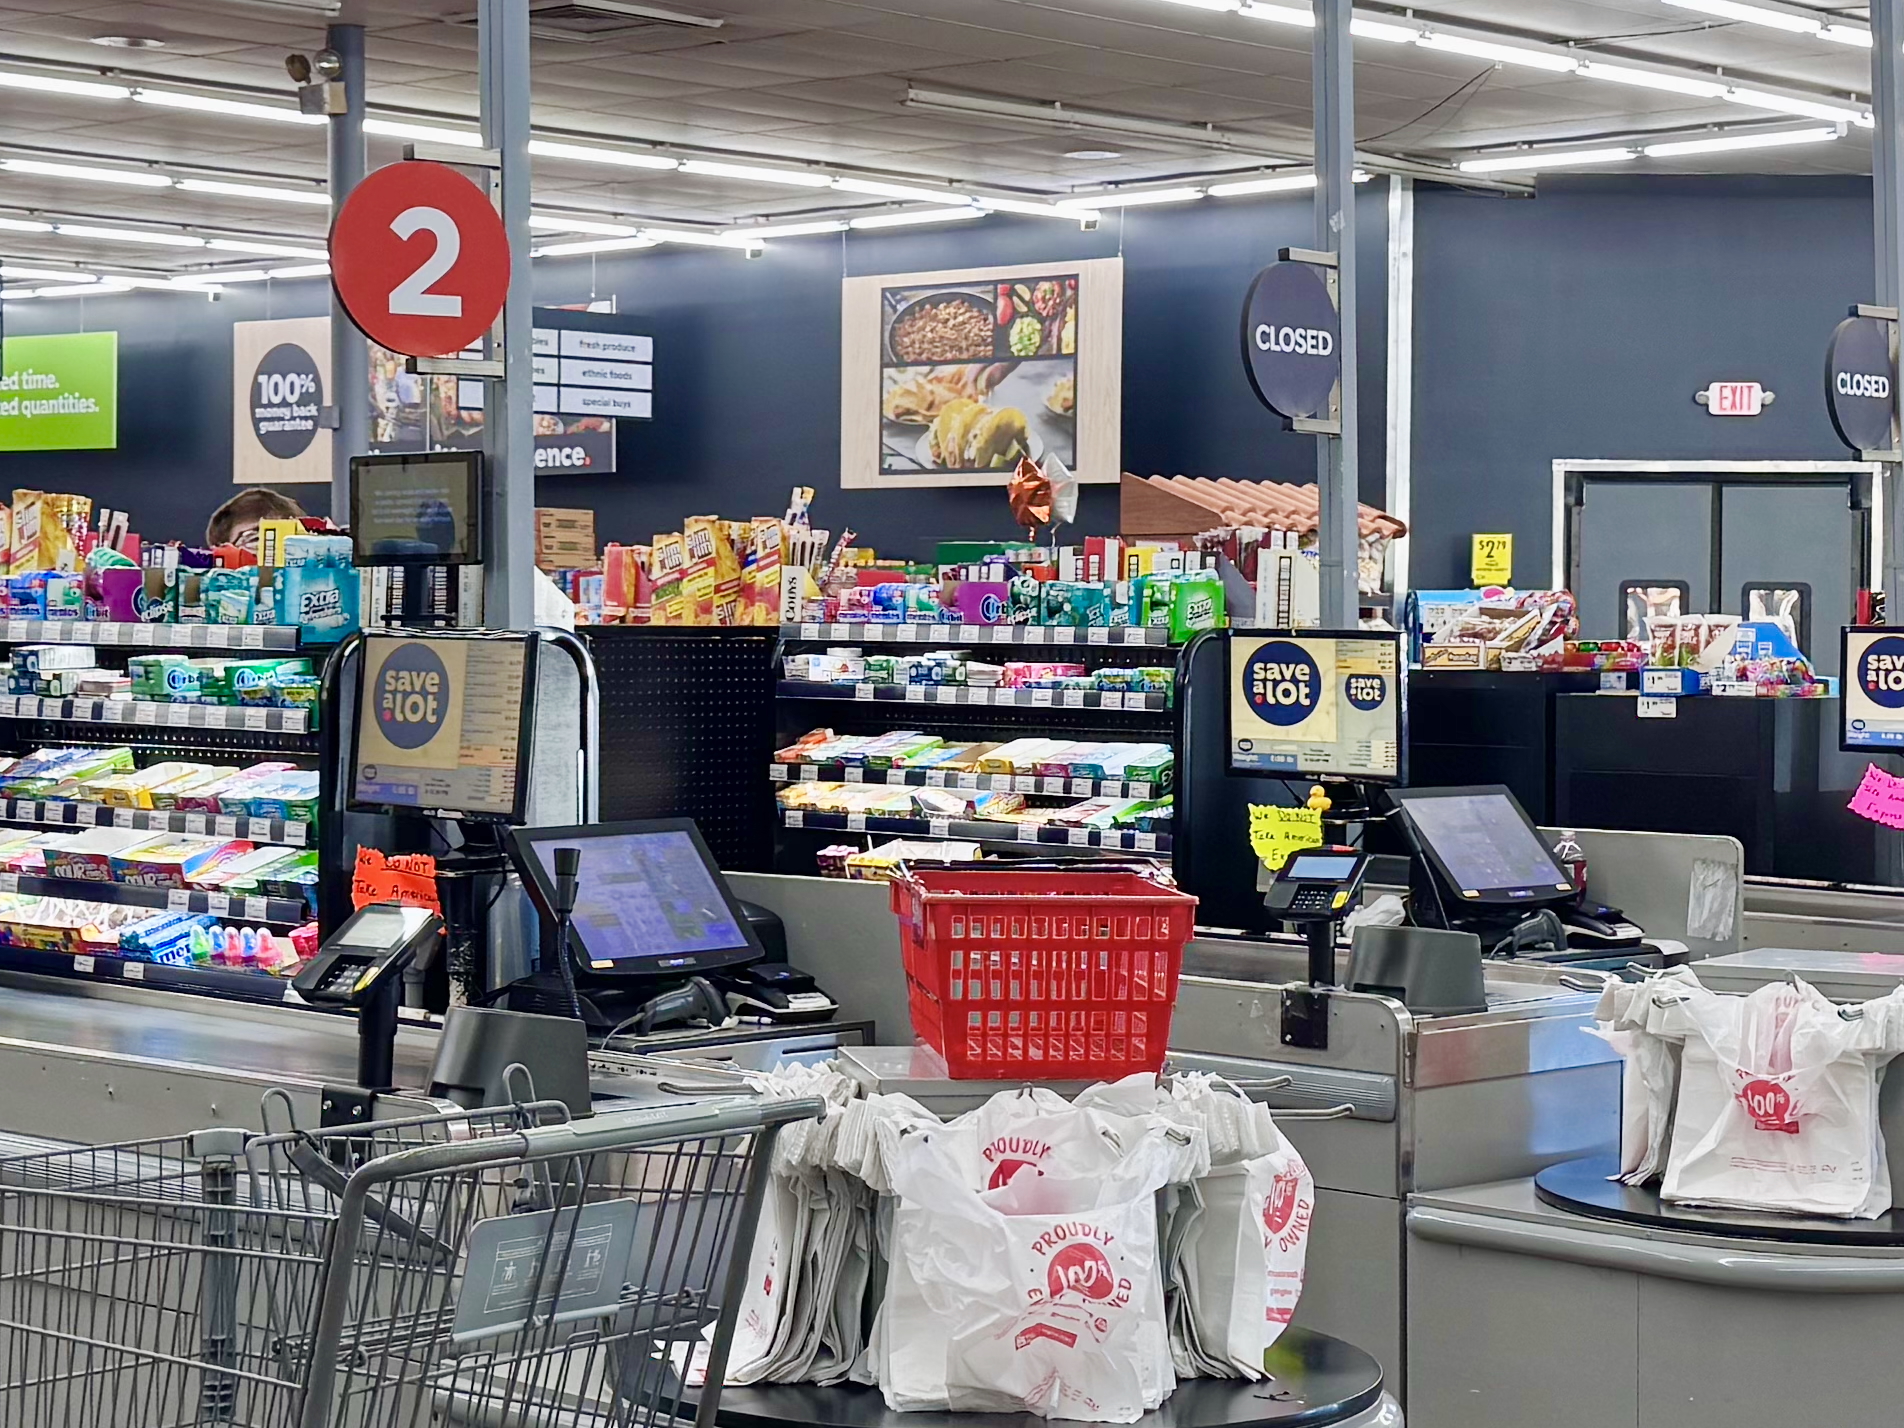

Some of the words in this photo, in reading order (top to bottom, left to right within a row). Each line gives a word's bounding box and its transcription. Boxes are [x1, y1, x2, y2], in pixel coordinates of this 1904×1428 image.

[388, 206, 462, 318] 2
[579, 340, 601, 349] fresh
[603, 343, 636, 353] produce
[1255, 324, 1333, 356] CLOSED
[22, 372, 60, 390] time.
[610, 372, 632, 380] foods
[1837, 372, 1890, 399] CLOSED
[257, 373, 315, 404] 100%
[1719, 385, 1755, 412] EXIT
[21, 393, 100, 422] quantities.
[255, 408, 291, 419] money
[292, 403, 318, 416] back
[259, 418, 314, 434] guarantee
[534, 446, 592, 467] ence.
[300, 590, 339, 614] Extra
[384, 670, 440, 692] save
[1253, 662, 1310, 681] save
[1867, 671, 1877, 681] a
[1253, 683, 1264, 694] a
[1266, 681, 1310, 706] lot
[1350, 677, 1381, 689] save
[1356, 688, 1381, 701] lot
[382, 694, 394, 710] a
[395, 693, 438, 723] lot
[406, 861, 428, 873] NOT
[1279, 1198, 1311, 1253] OWNED
[1031, 1222, 1114, 1257] PROUDLY
